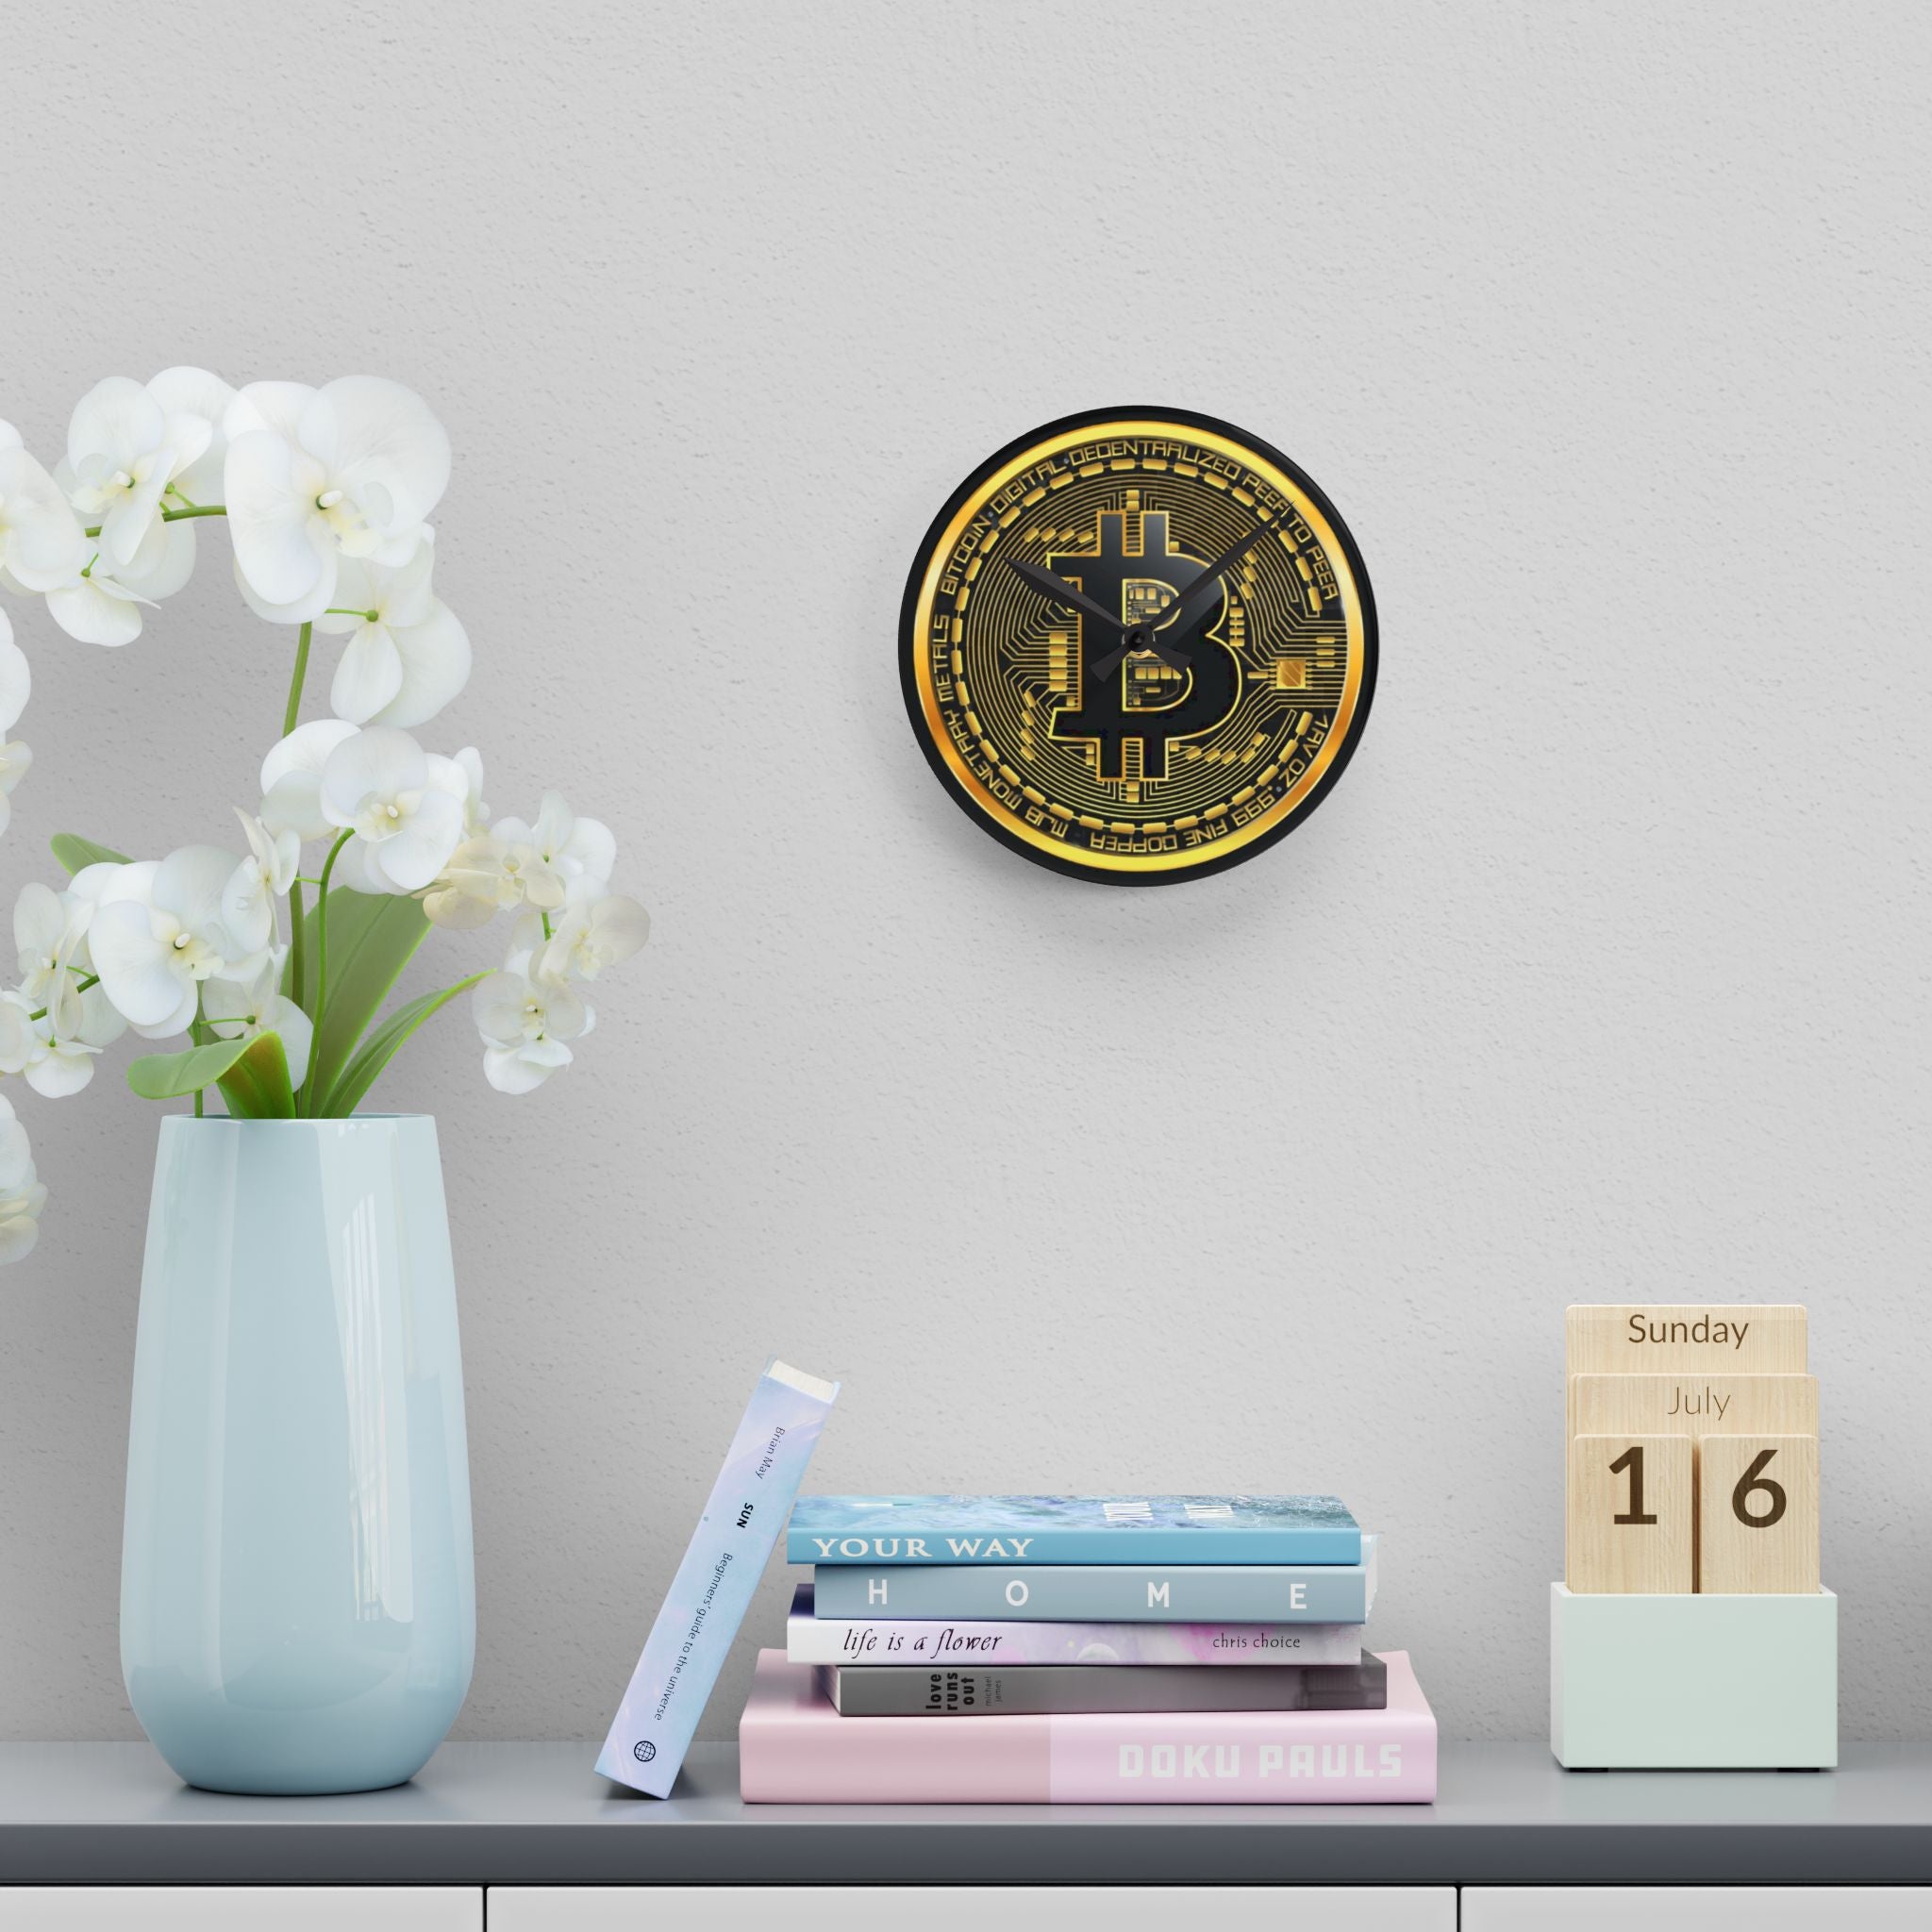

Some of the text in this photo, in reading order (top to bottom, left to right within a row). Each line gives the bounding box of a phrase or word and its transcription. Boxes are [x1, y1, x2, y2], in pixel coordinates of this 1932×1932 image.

[940, 514, 993, 595] BITCOIN
[991, 459, 1068, 514] DIGITAL
[1288, 512, 1312, 543] TO
[1306, 544, 1340, 601] PEER
[932, 614, 955, 702] METALS
[943, 709, 1023, 811] MONETARY
[1183, 819, 1228, 846] FINE
[1628, 1314, 1749, 1350] Sunday
[1667, 1386, 1731, 1421] July
[755, 1426, 786, 1479] Brian May
[736, 1502, 754, 1529] SUN
[812, 1538, 1034, 1557] YOUR WAY
[688, 1607, 707, 1640] guide
[1212, 1632, 1301, 1648] chris choice
[681, 1641, 693, 1653] to
[843, 1628, 1003, 1659] life is a flower
[674, 1654, 687, 1674] the
[654, 1675, 679, 1721] universe
[925, 1674, 941, 1709] love
[946, 1672, 958, 1710] runs
[961, 1677, 974, 1706] out
[1118, 1743, 1402, 1778] DOKU PAULS
